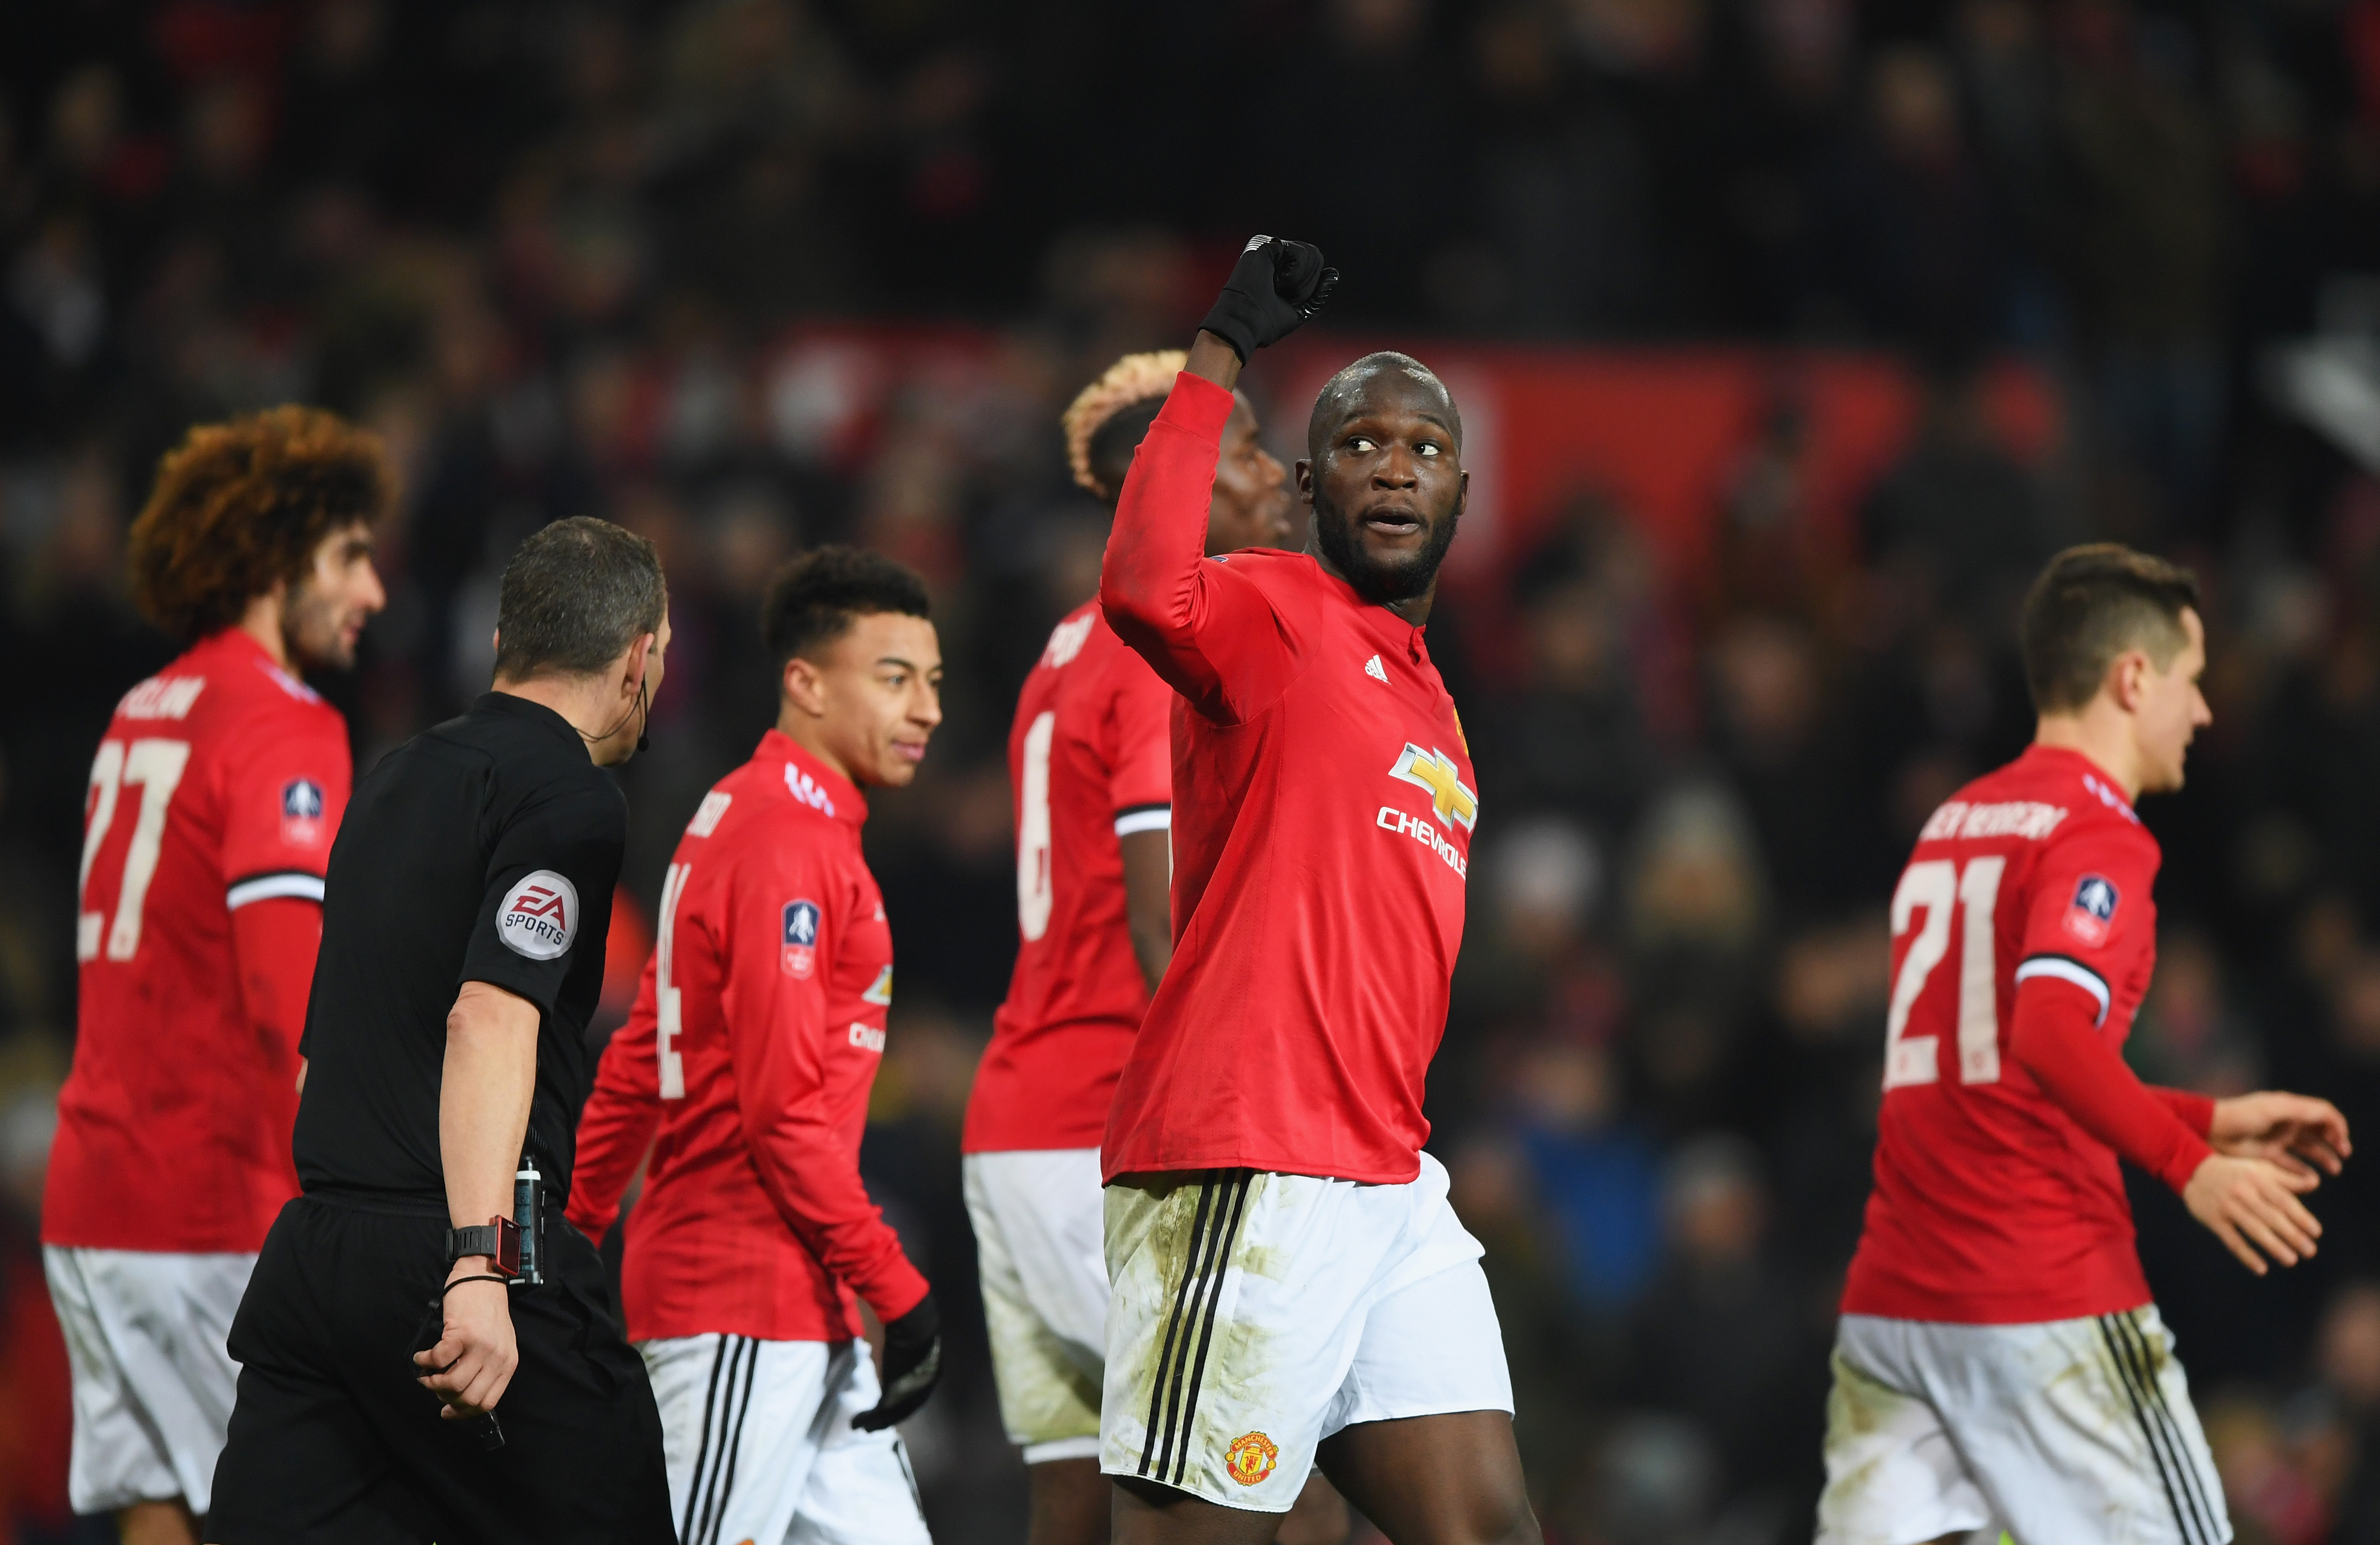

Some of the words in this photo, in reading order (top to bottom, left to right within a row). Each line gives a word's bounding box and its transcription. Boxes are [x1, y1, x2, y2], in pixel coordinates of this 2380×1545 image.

[77, 739, 191, 963] 27
[510, 885, 567, 932] EA
[505, 913, 565, 946] SPORTS
[1883, 855, 2007, 1091] 21
[1234, 1435, 1274, 1456] MANCHESTER
[1233, 1470, 1261, 1482] UNITED
